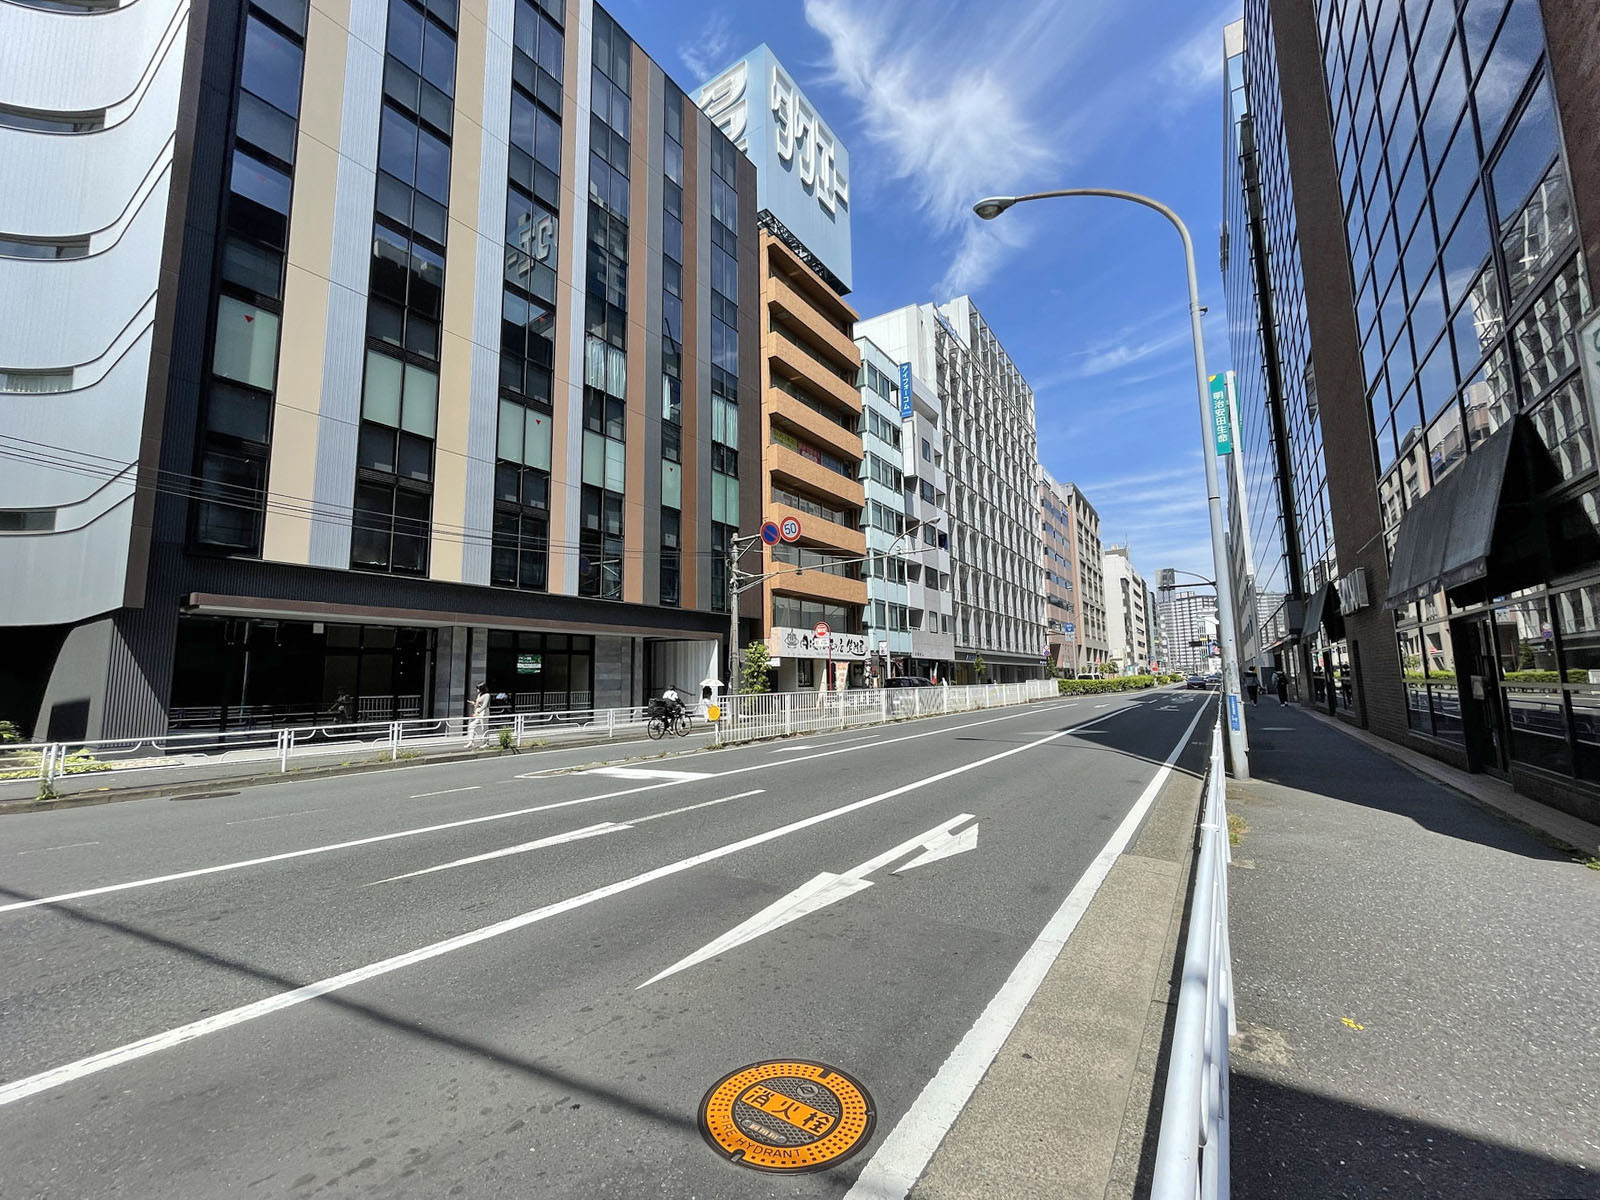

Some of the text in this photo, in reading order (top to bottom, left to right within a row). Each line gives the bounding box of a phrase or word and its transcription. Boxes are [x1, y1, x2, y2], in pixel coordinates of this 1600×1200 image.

[697, 59, 748, 154] タク
[1213, 391, 1227, 442] 明治安田生命
[784, 522, 797, 535] 50
[745, 1086, 828, 1134] 消火栓
[719, 1115, 737, 1137] FIRE
[736, 1137, 801, 1159] HYDRANT
